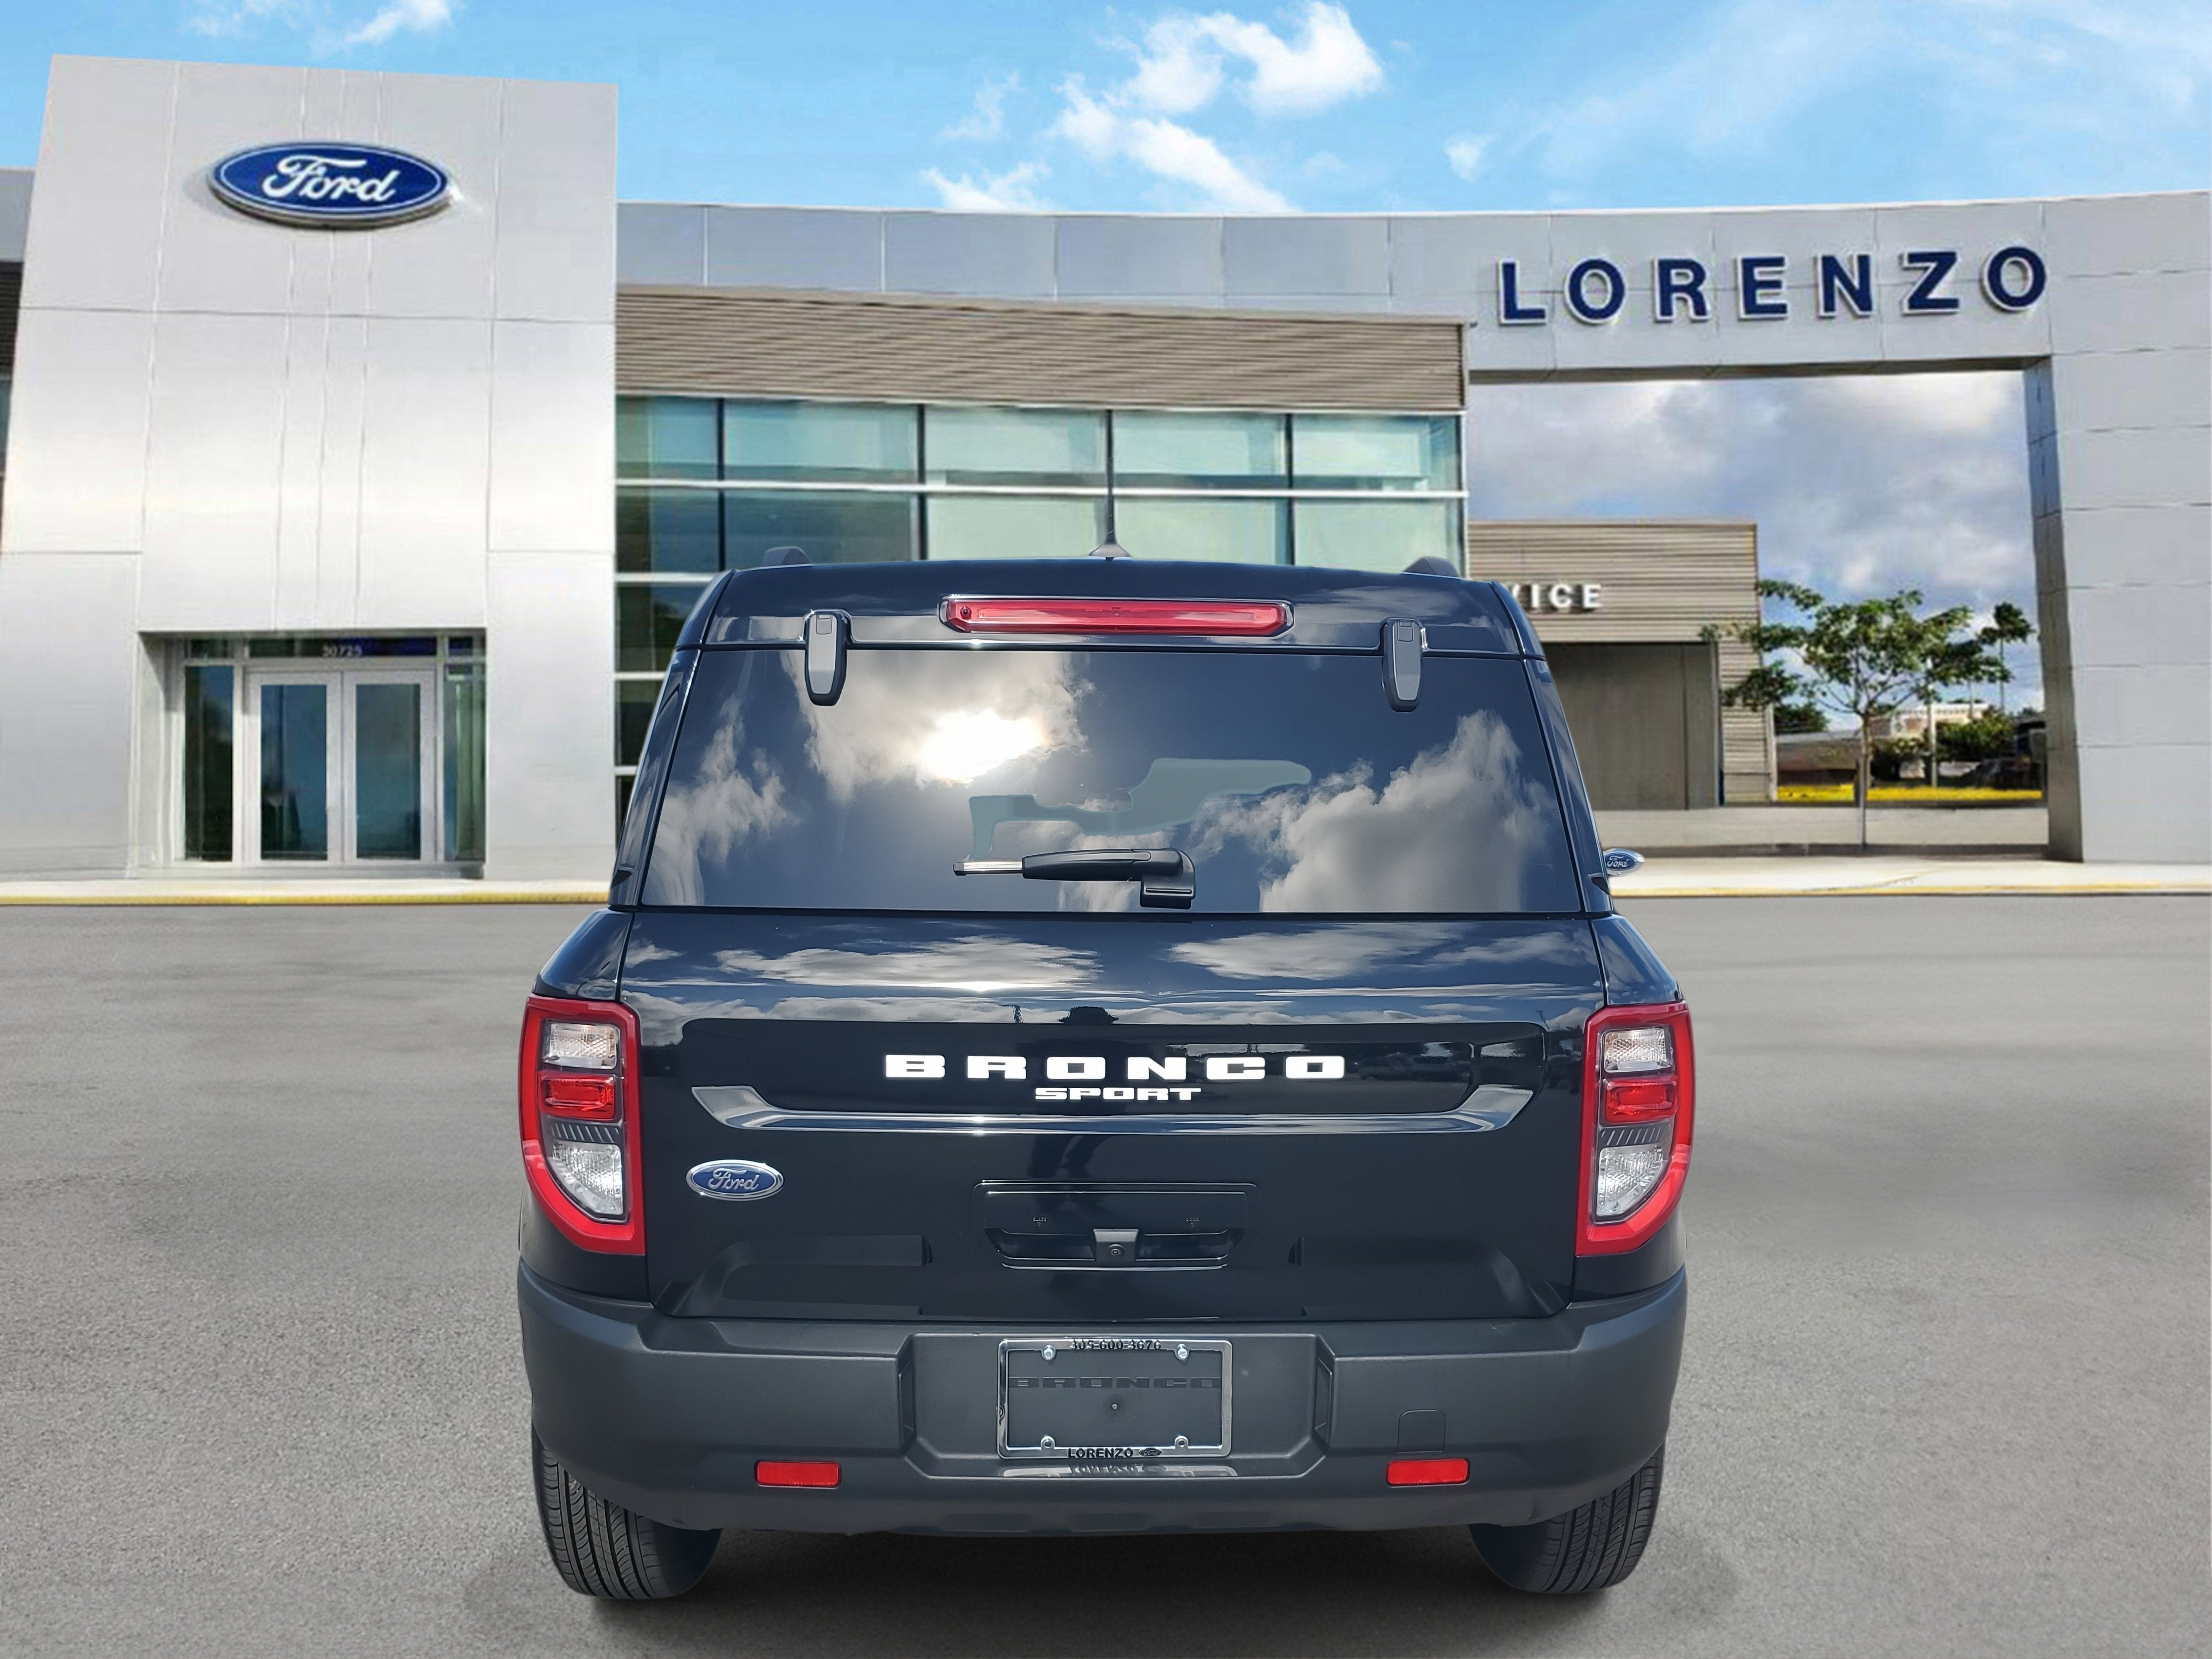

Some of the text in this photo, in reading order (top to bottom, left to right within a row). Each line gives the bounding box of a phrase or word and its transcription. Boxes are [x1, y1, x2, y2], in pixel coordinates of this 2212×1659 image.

[262, 154, 400, 201] Ford
[1499, 246, 2047, 323] LORENZO
[885, 1054, 1345, 1081] BRONCO
[1035, 1087, 1202, 1101] SPORT
[707, 1167, 761, 1191] Ford
[1069, 1338, 1162, 1350] 305-600-3676
[1009, 1377, 1221, 1388] BRONCO
[1068, 1447, 1133, 1458] LORENZO
